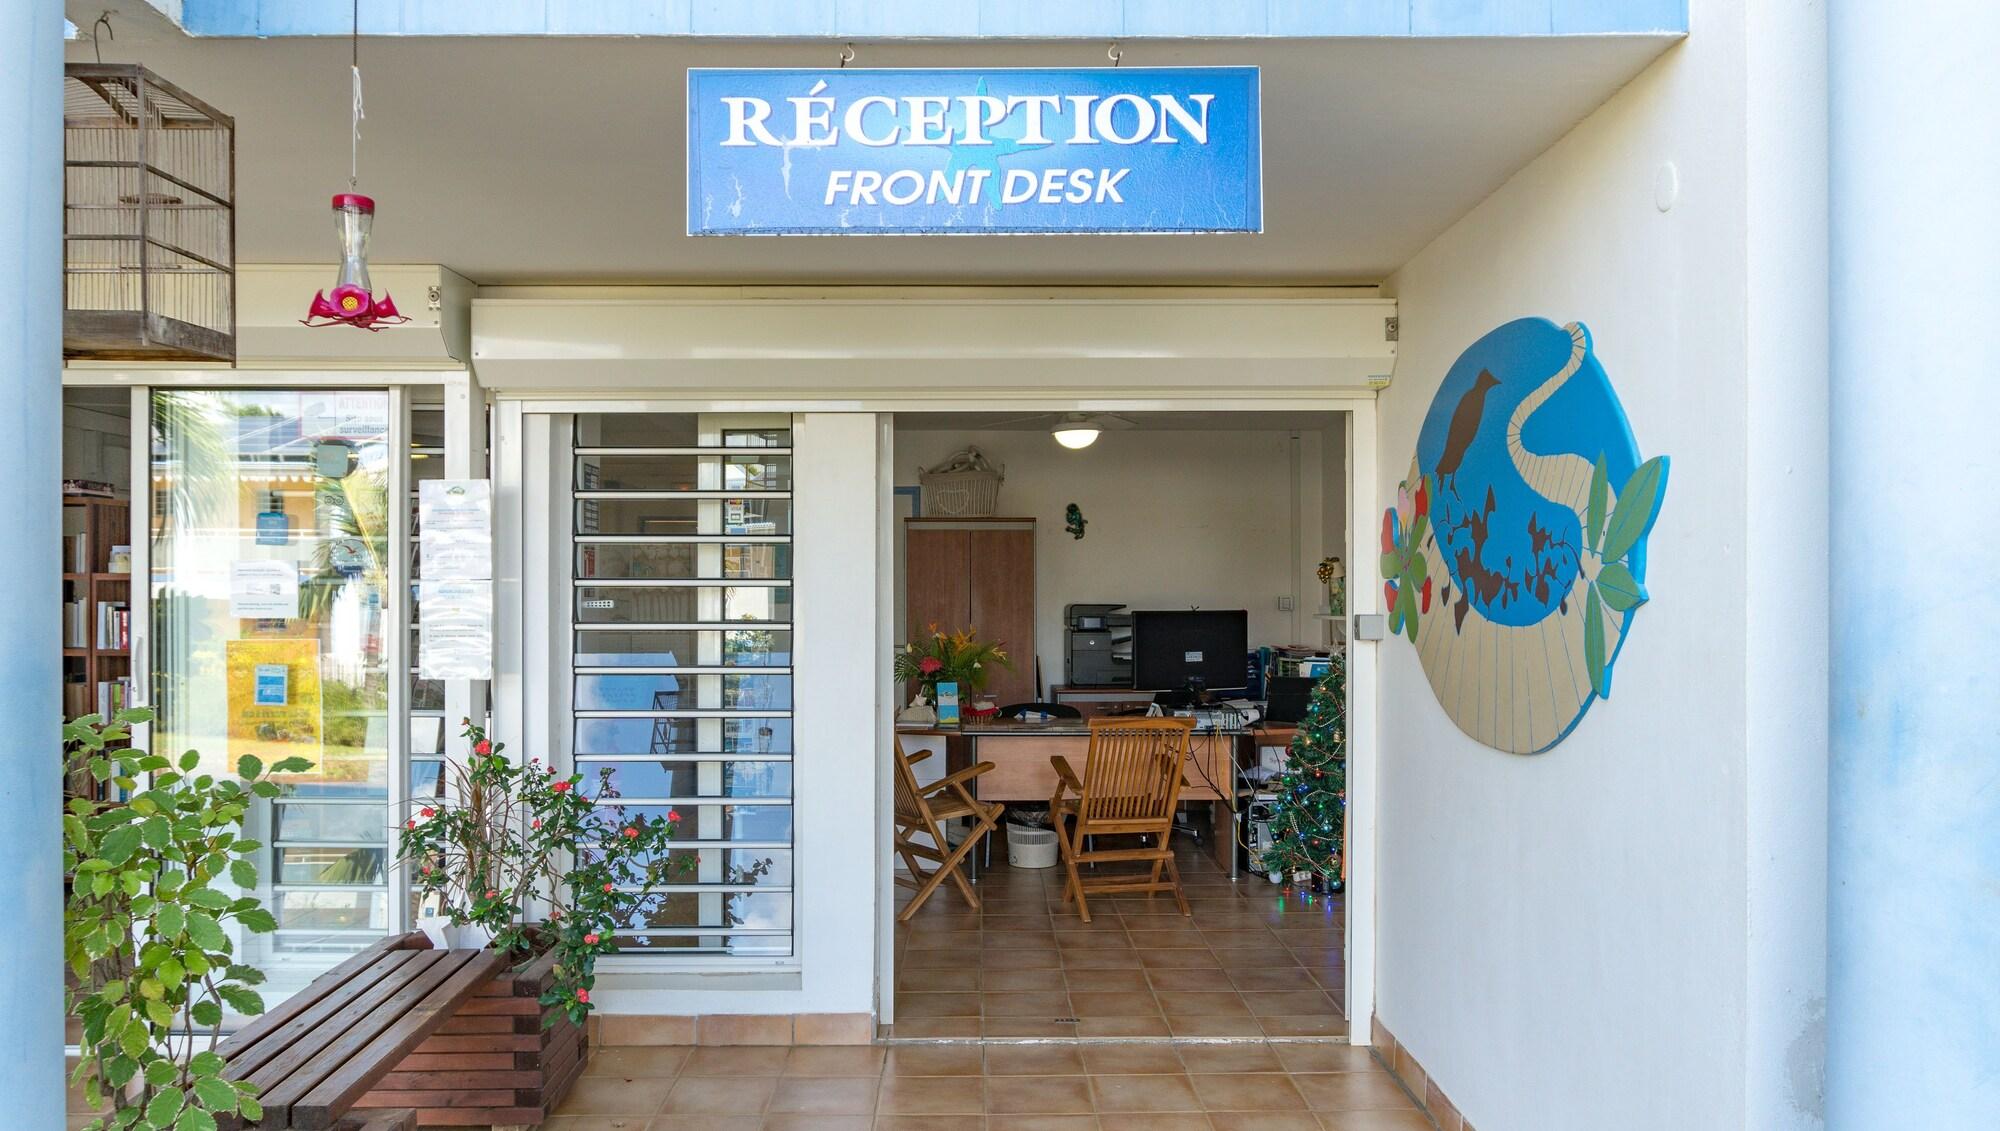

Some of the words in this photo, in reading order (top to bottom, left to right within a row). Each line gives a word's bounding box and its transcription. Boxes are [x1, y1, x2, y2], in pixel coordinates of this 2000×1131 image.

[719, 80, 1214, 147] RÉCEPTION
[825, 168, 990, 206] FRONT
[1002, 168, 1130, 204] DESK
